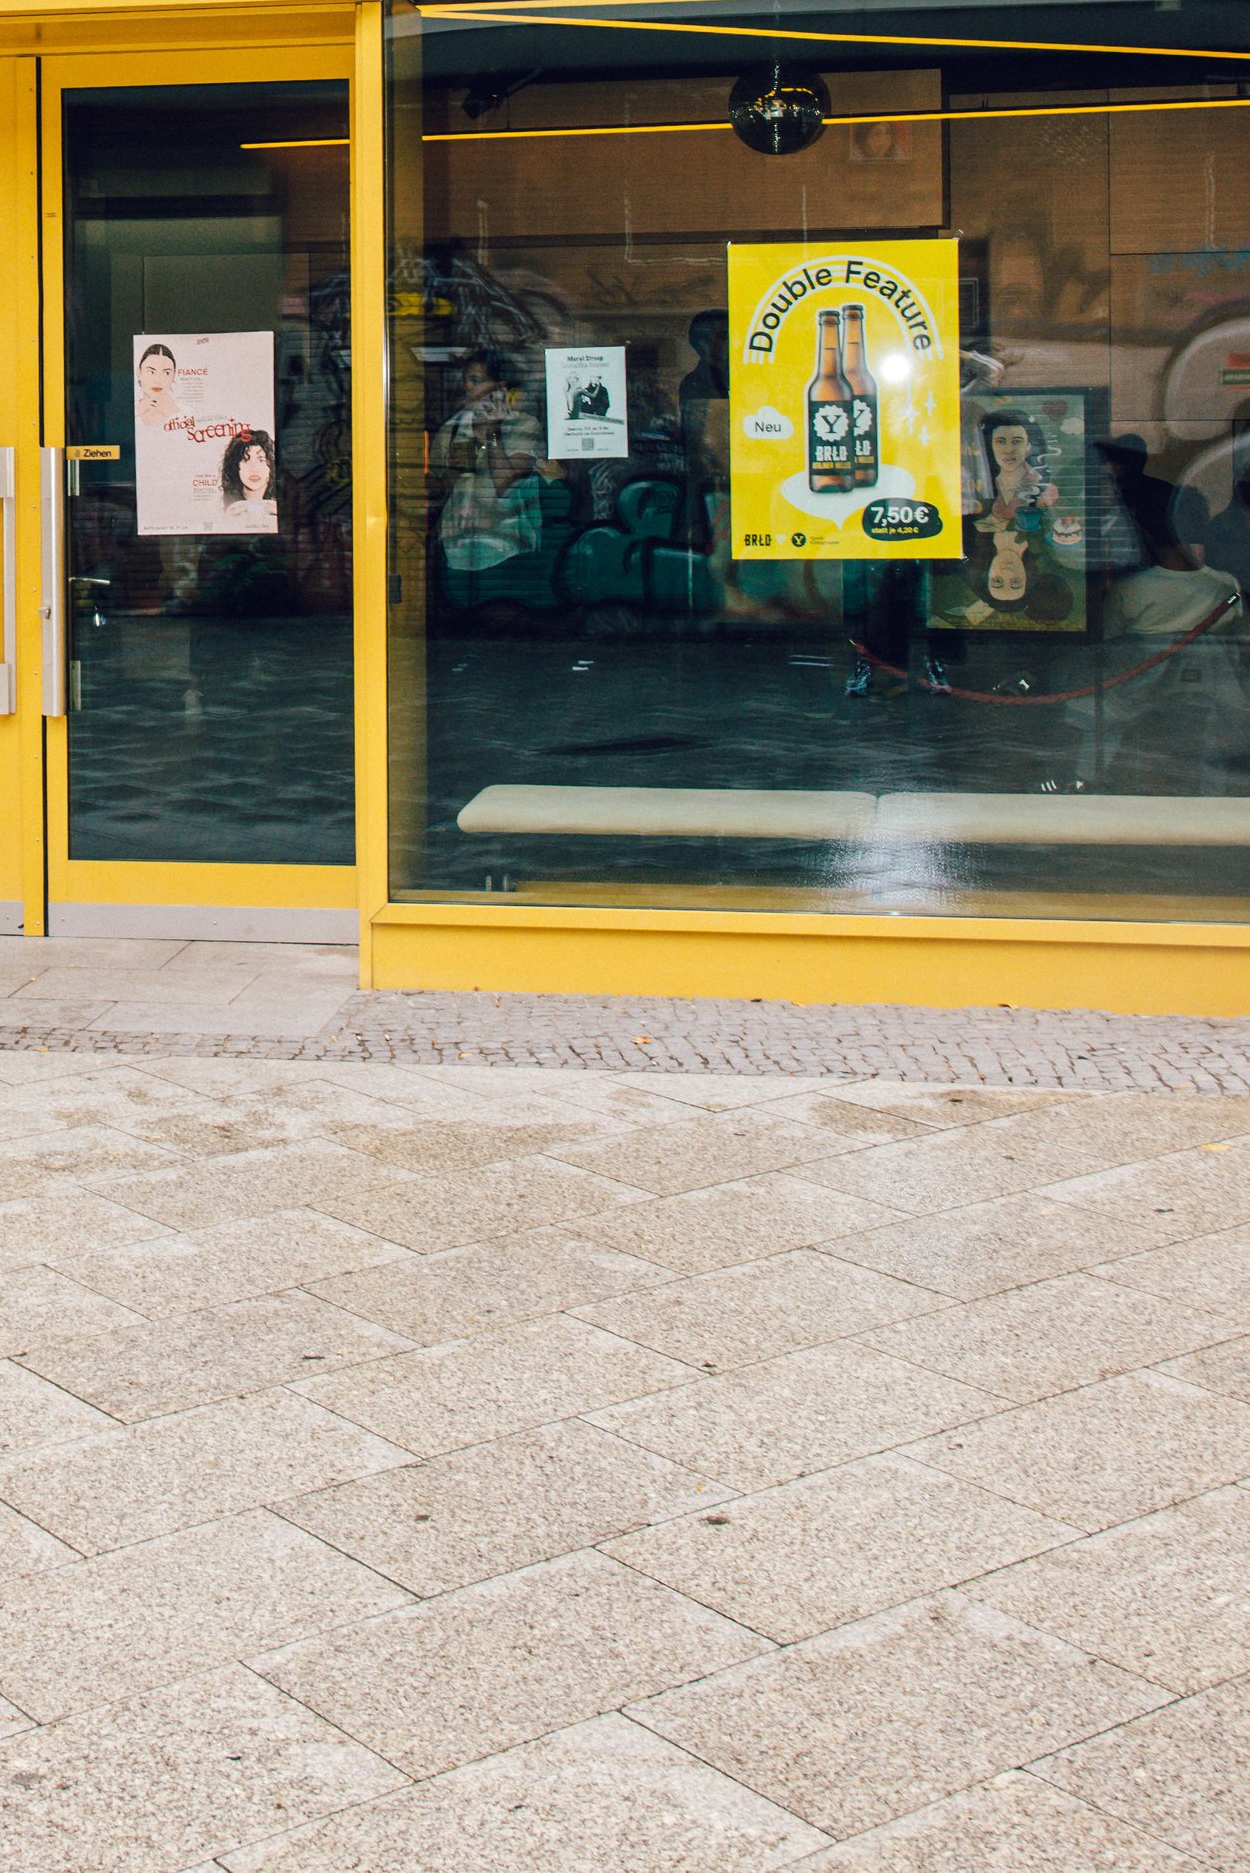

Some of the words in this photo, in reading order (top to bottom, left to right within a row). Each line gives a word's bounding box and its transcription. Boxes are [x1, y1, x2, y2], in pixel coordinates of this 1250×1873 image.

[748, 267, 833, 354] Double
[844, 260, 933, 351] Feature
[177, 366, 209, 376] FIANCÉ
[754, 421, 782, 433] Neu
[83, 448, 112, 458] Ziehen
[192, 478, 218, 487] CHILD
[870, 506, 930, 526] 7,50€
